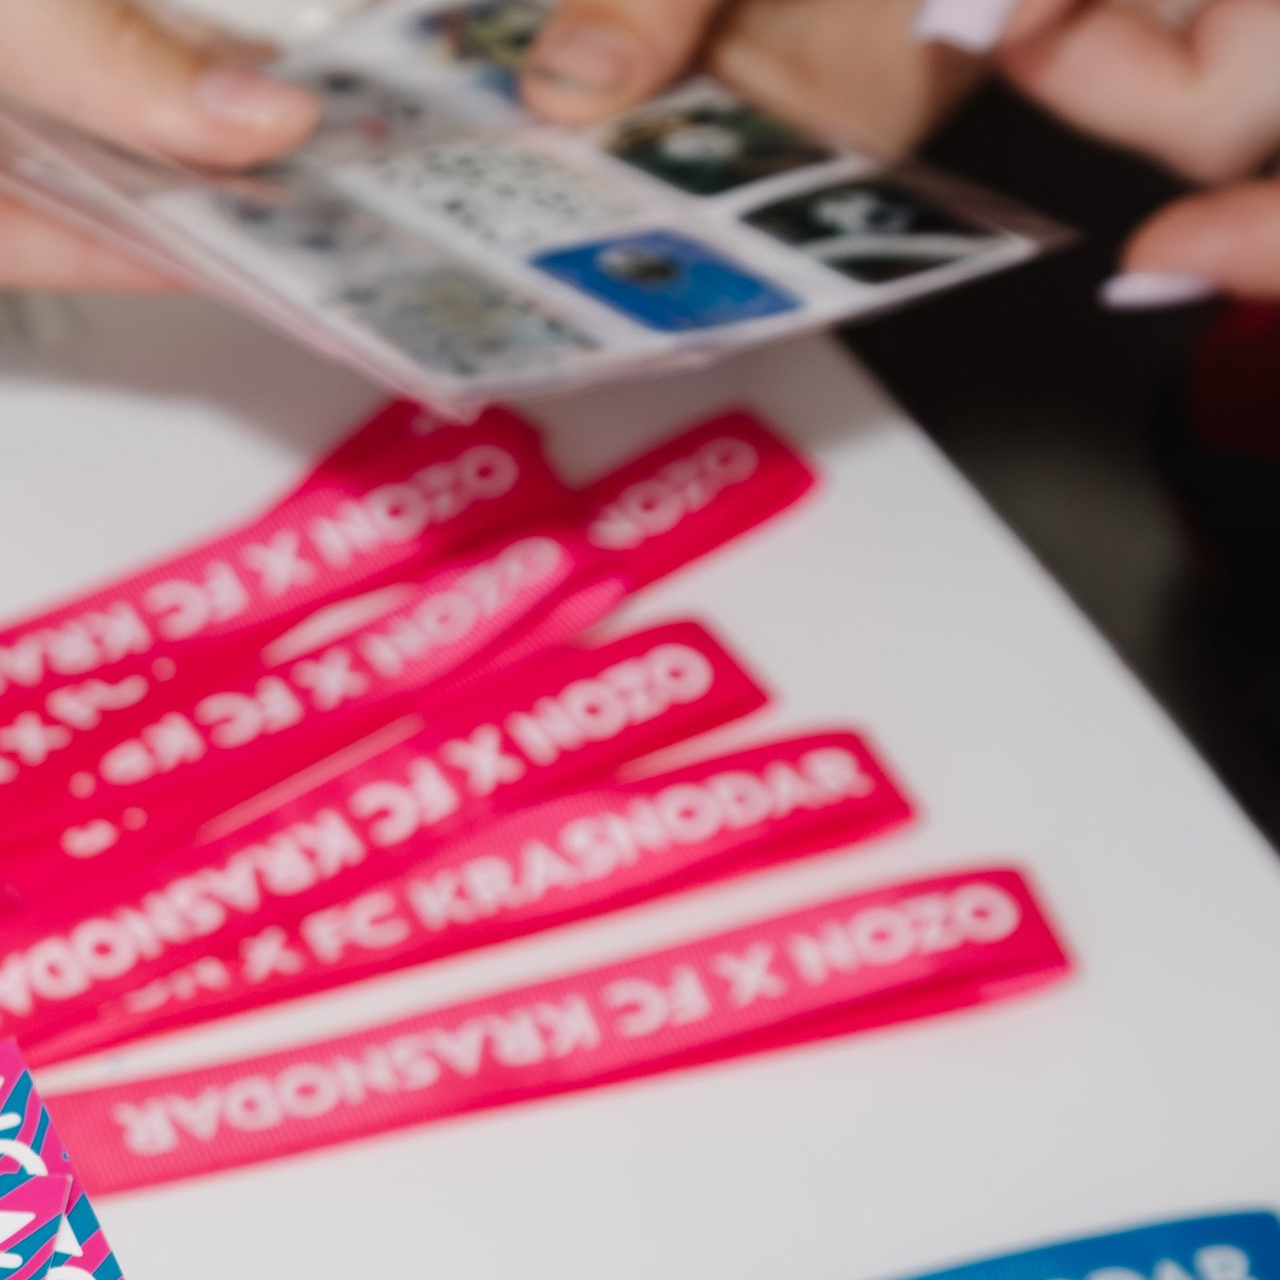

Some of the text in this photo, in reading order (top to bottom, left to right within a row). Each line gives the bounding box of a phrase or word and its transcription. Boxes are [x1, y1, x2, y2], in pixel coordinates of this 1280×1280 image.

[309, 444, 519, 569] OZON
[142, 558, 251, 641] FC
[239, 530, 317, 598] X
[195, 675, 306, 749] FC
[290, 647, 369, 712] X
[507, 644, 714, 763] OZON
[350, 758, 459, 846] FC
[444, 725, 524, 796] X
[240, 746, 873, 983] X FC KRASNODAR
[112, 883, 1022, 1160] OZON X FC KRASNODAR
